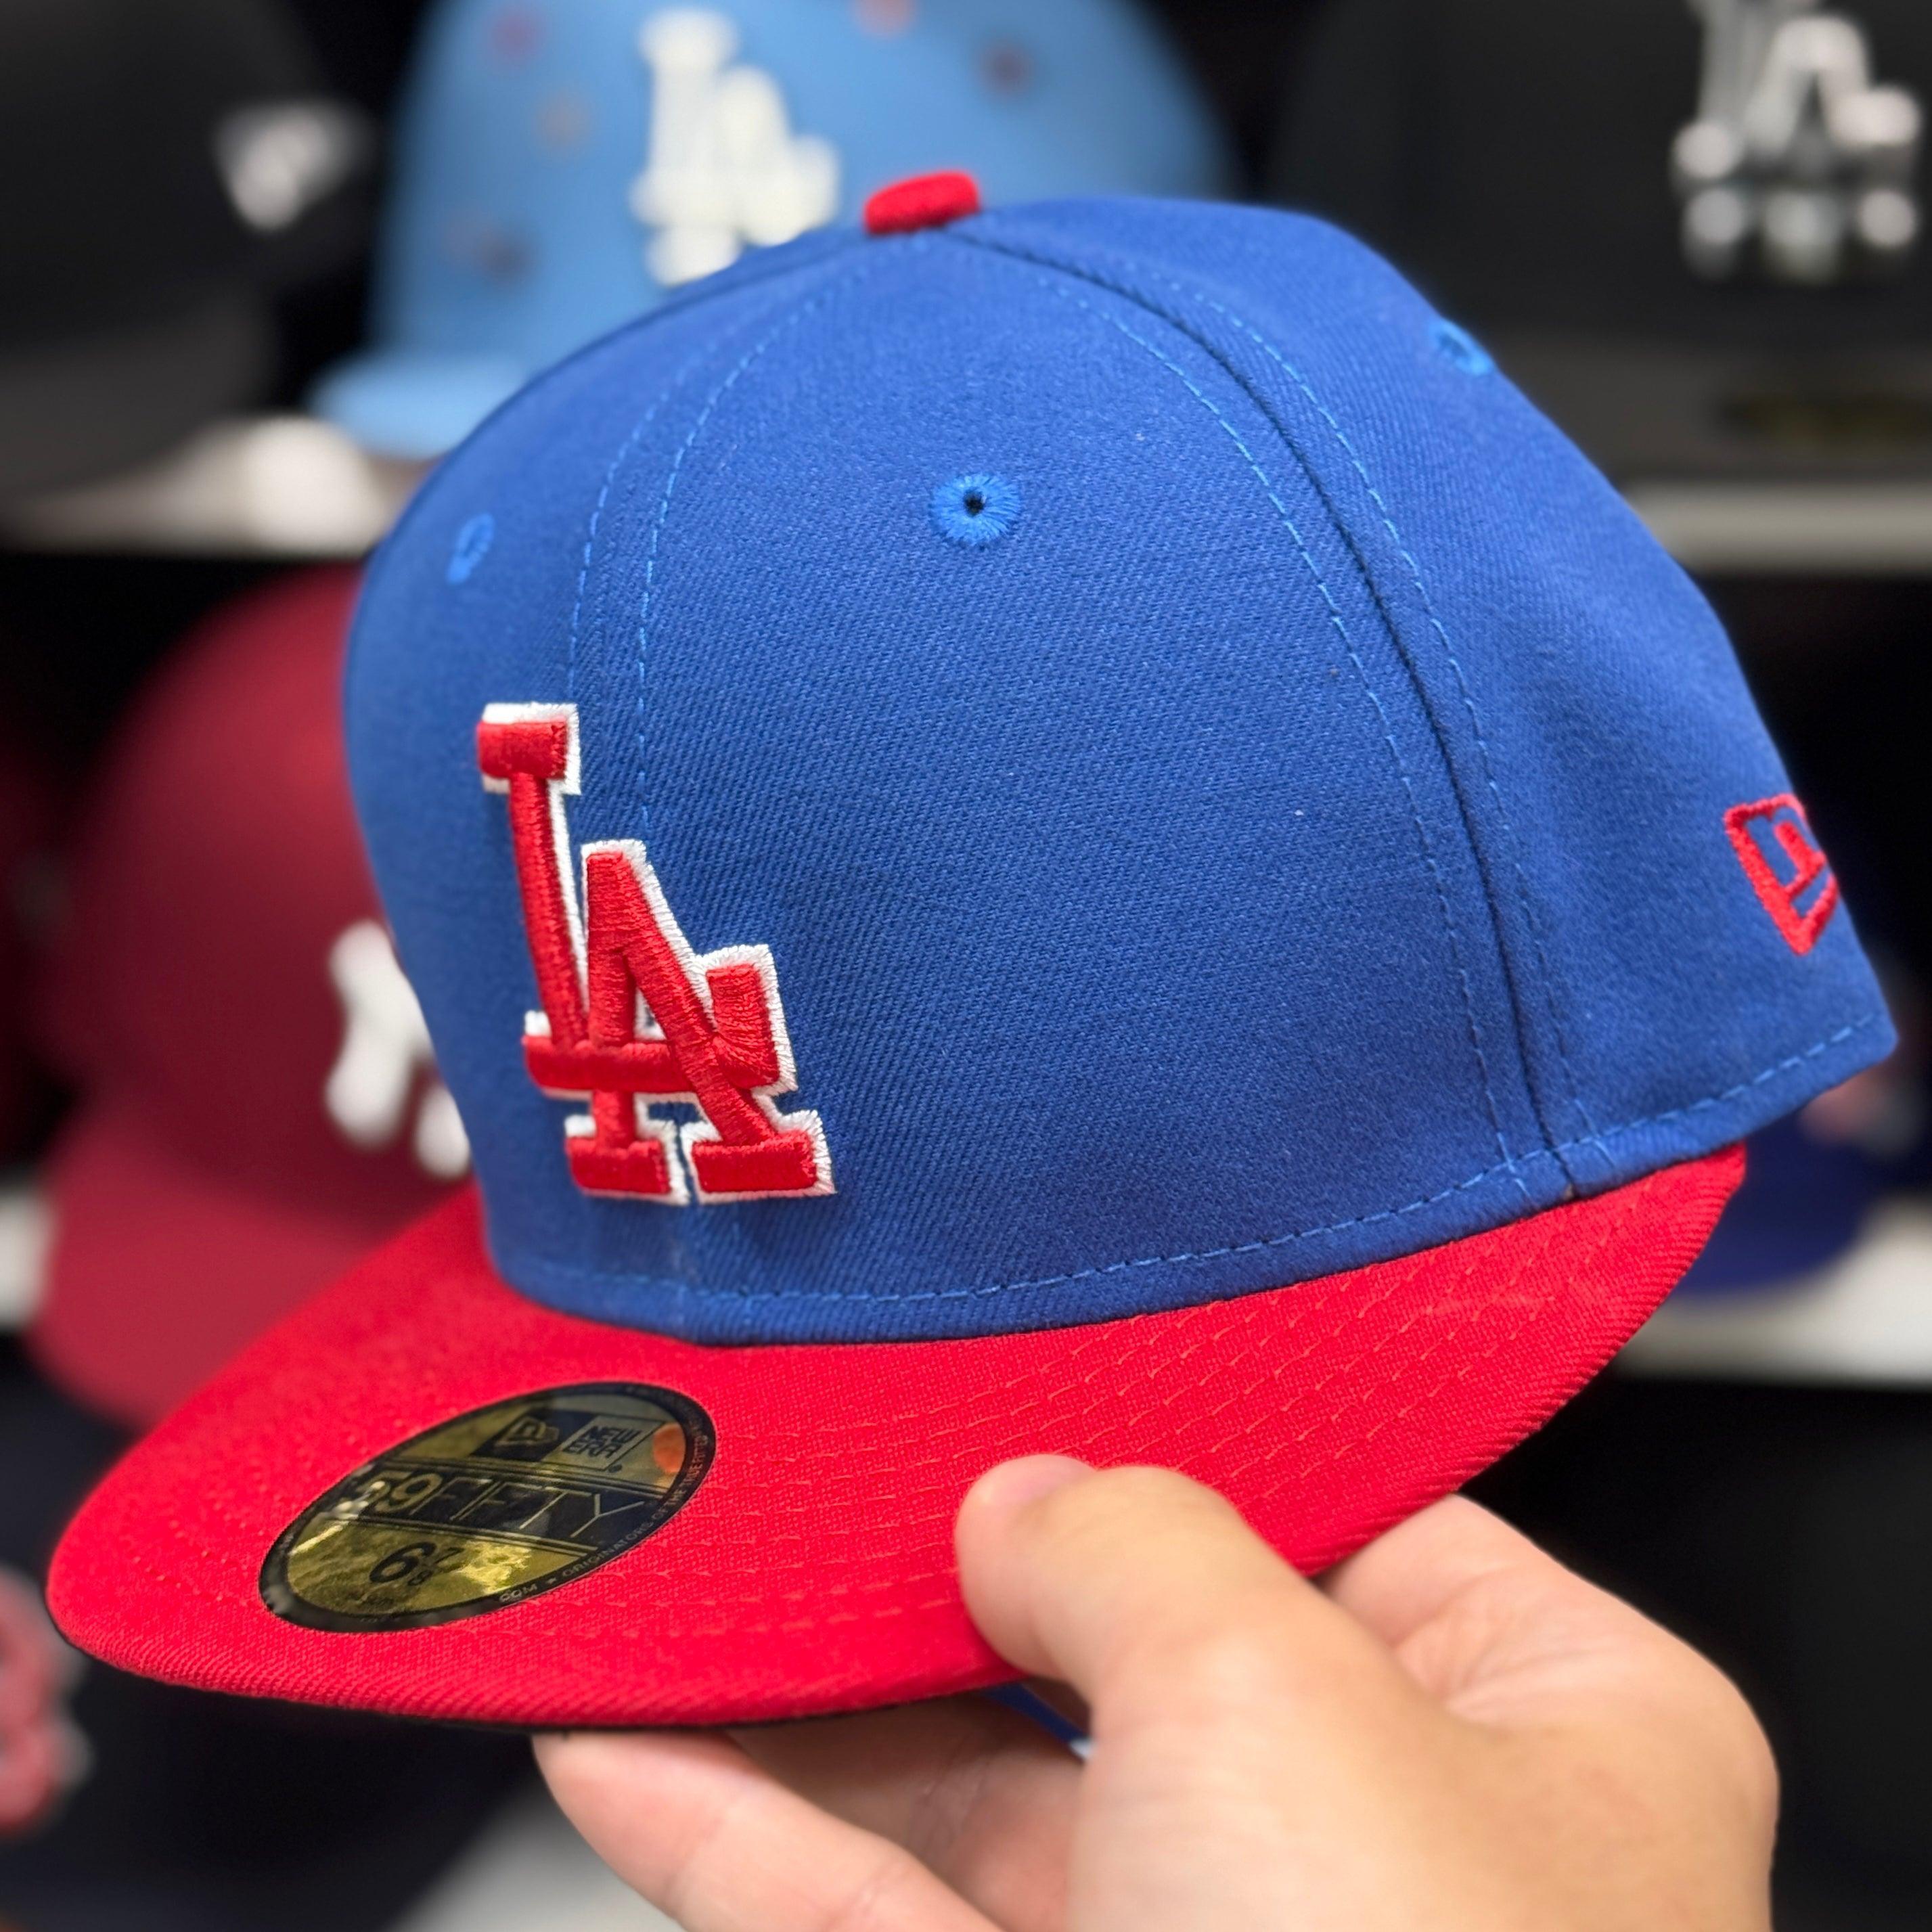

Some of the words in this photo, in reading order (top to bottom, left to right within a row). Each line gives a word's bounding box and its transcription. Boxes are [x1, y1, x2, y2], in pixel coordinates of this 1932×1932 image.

[477, 702, 836, 1205] LA
[562, 1439, 623, 1459] ERA
[584, 1425, 643, 1444] NEW
[342, 1470, 645, 1538] 59FIFTY
[562, 1521, 654, 1577] ORIGINATORS
